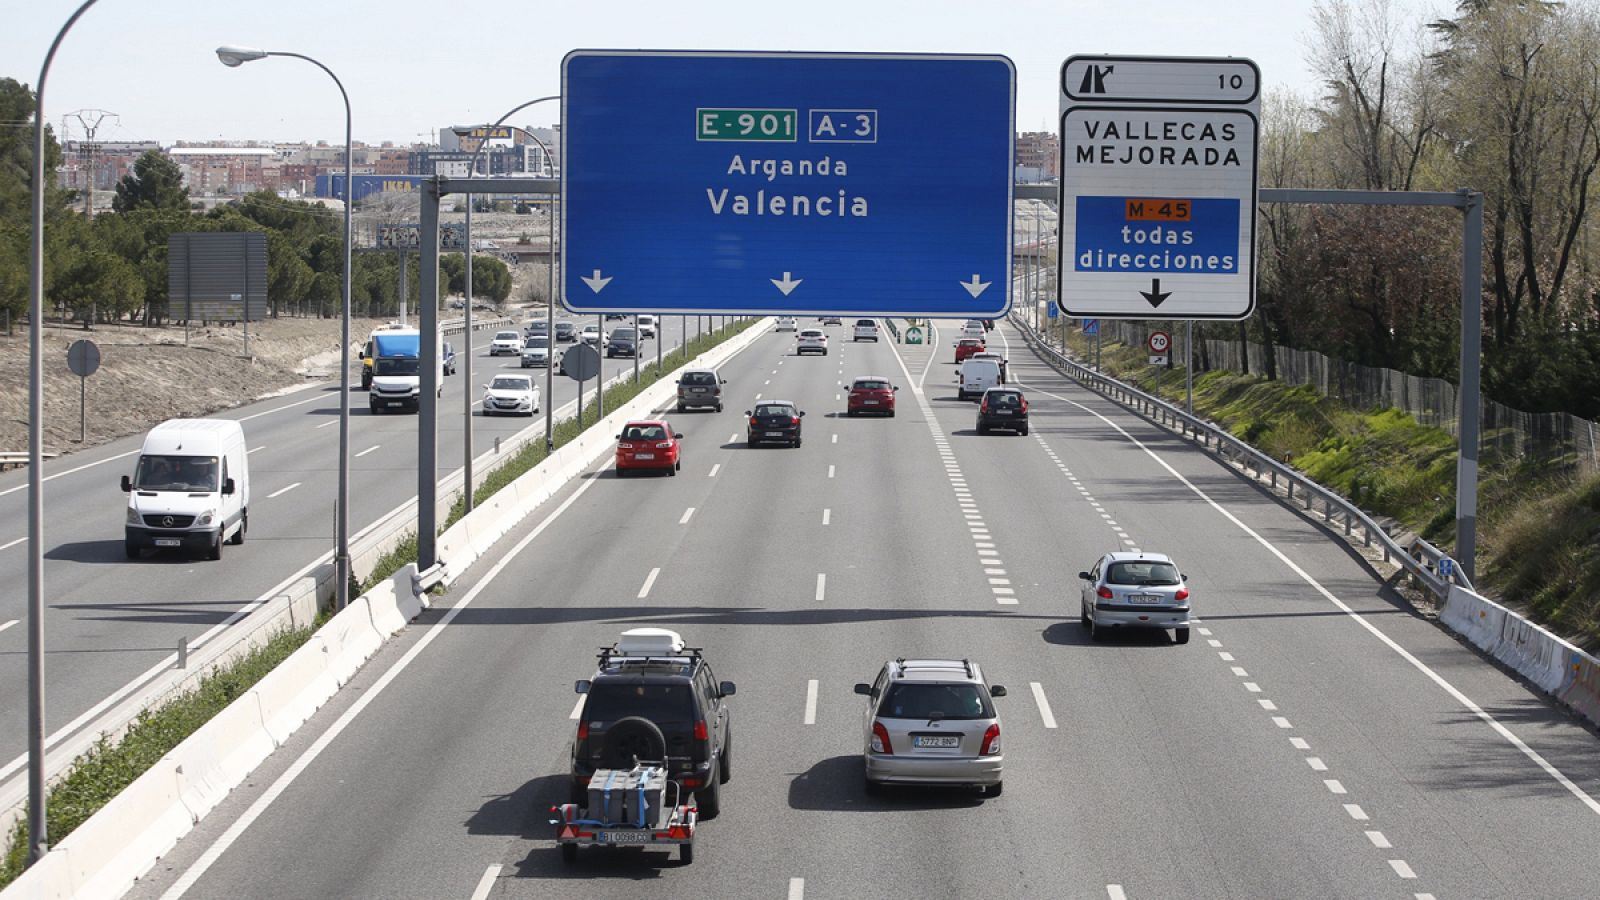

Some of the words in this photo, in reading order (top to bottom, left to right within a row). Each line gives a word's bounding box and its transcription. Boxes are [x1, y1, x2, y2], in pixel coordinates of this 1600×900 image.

[1218, 74, 1243, 90] 10
[702, 114, 791, 135] E-901
[815, 114, 871, 136] A-3
[1084, 121, 1235, 141] VALLECAS
[1076, 145, 1240, 166] MEJORADA
[727, 155, 848, 181] Arganda
[383, 181, 412, 192] IKEA
[706, 188, 868, 217] Valencia
[1128, 202, 1188, 218] M-45
[1121, 225, 1193, 245] todas
[1079, 249, 1234, 269] direcciones
[1153, 338, 1166, 346] 70
